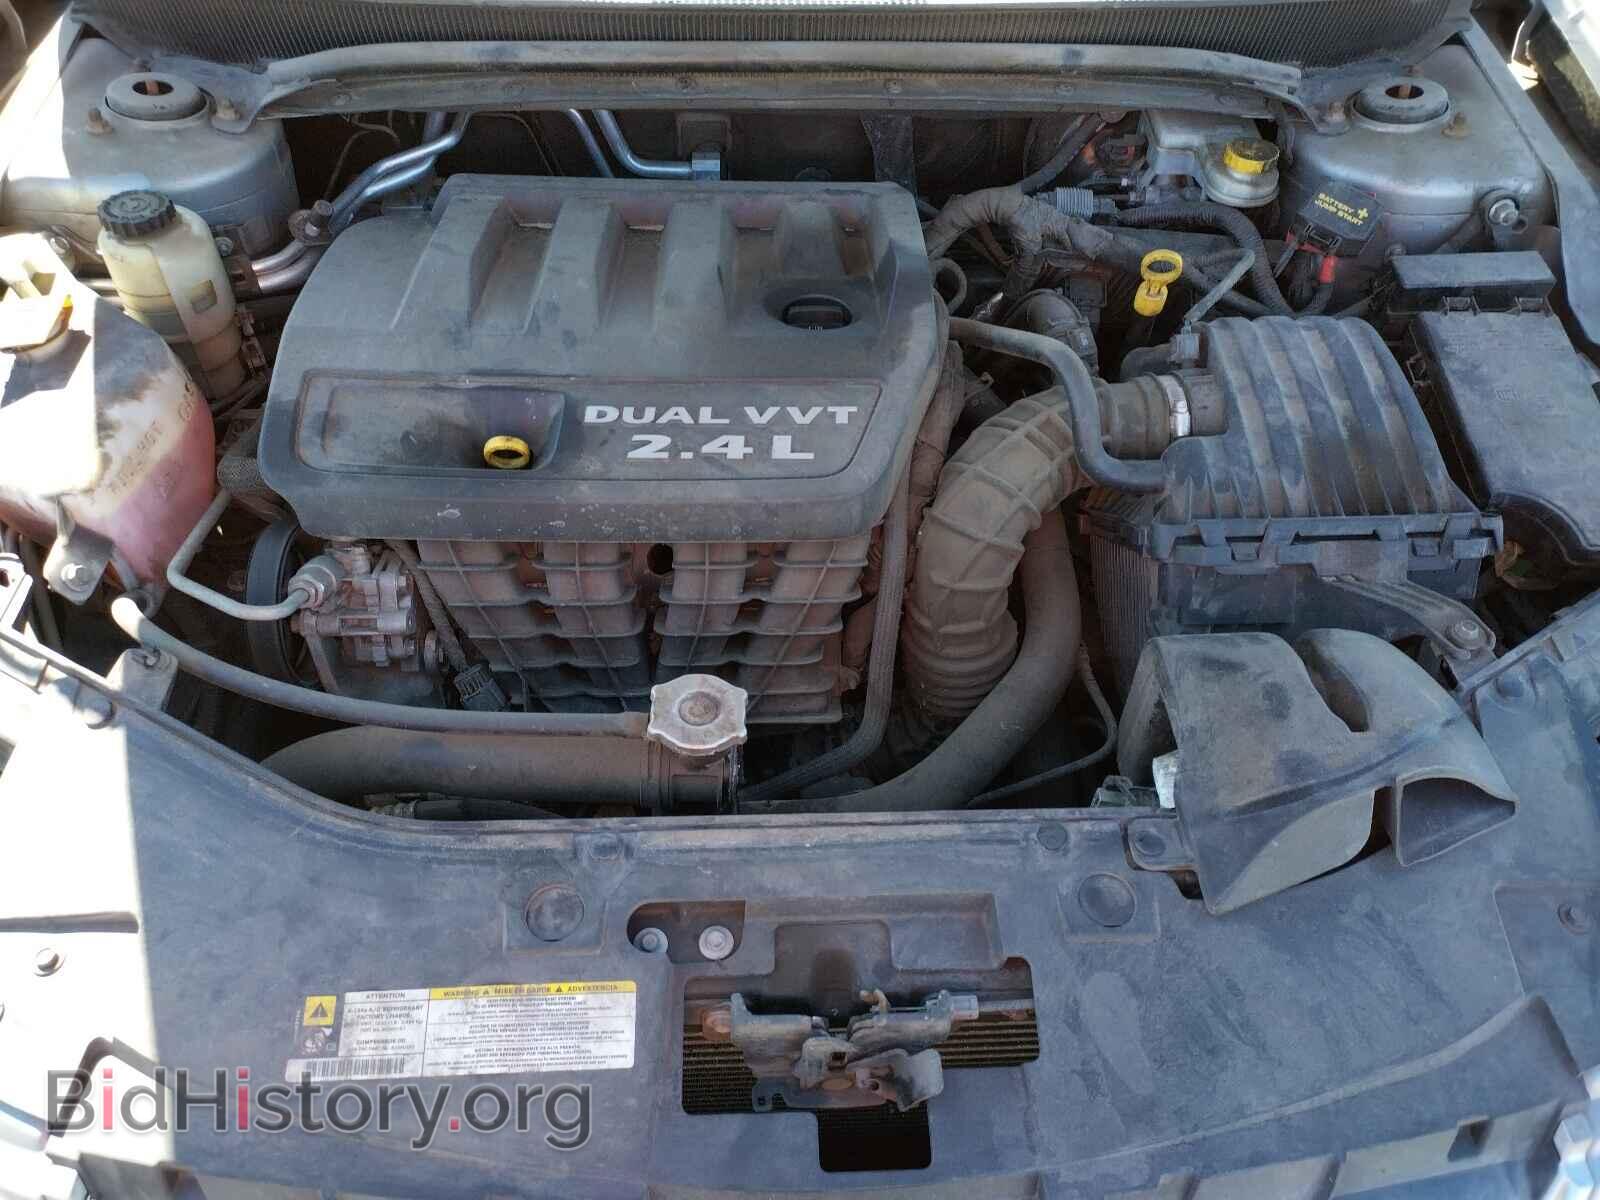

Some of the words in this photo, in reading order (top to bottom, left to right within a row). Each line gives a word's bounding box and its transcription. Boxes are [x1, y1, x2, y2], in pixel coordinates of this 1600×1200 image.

[1314, 199, 1338, 214] JUMP
[1336, 209, 1364, 226] START
[1318, 192, 1355, 214] BATTERY
[583, 405, 731, 425] DUAL
[744, 405, 859, 425] VVT
[626, 434, 755, 460] 2.4
[771, 434, 816, 460] L
[365, 992, 406, 1000] ATTENTION
